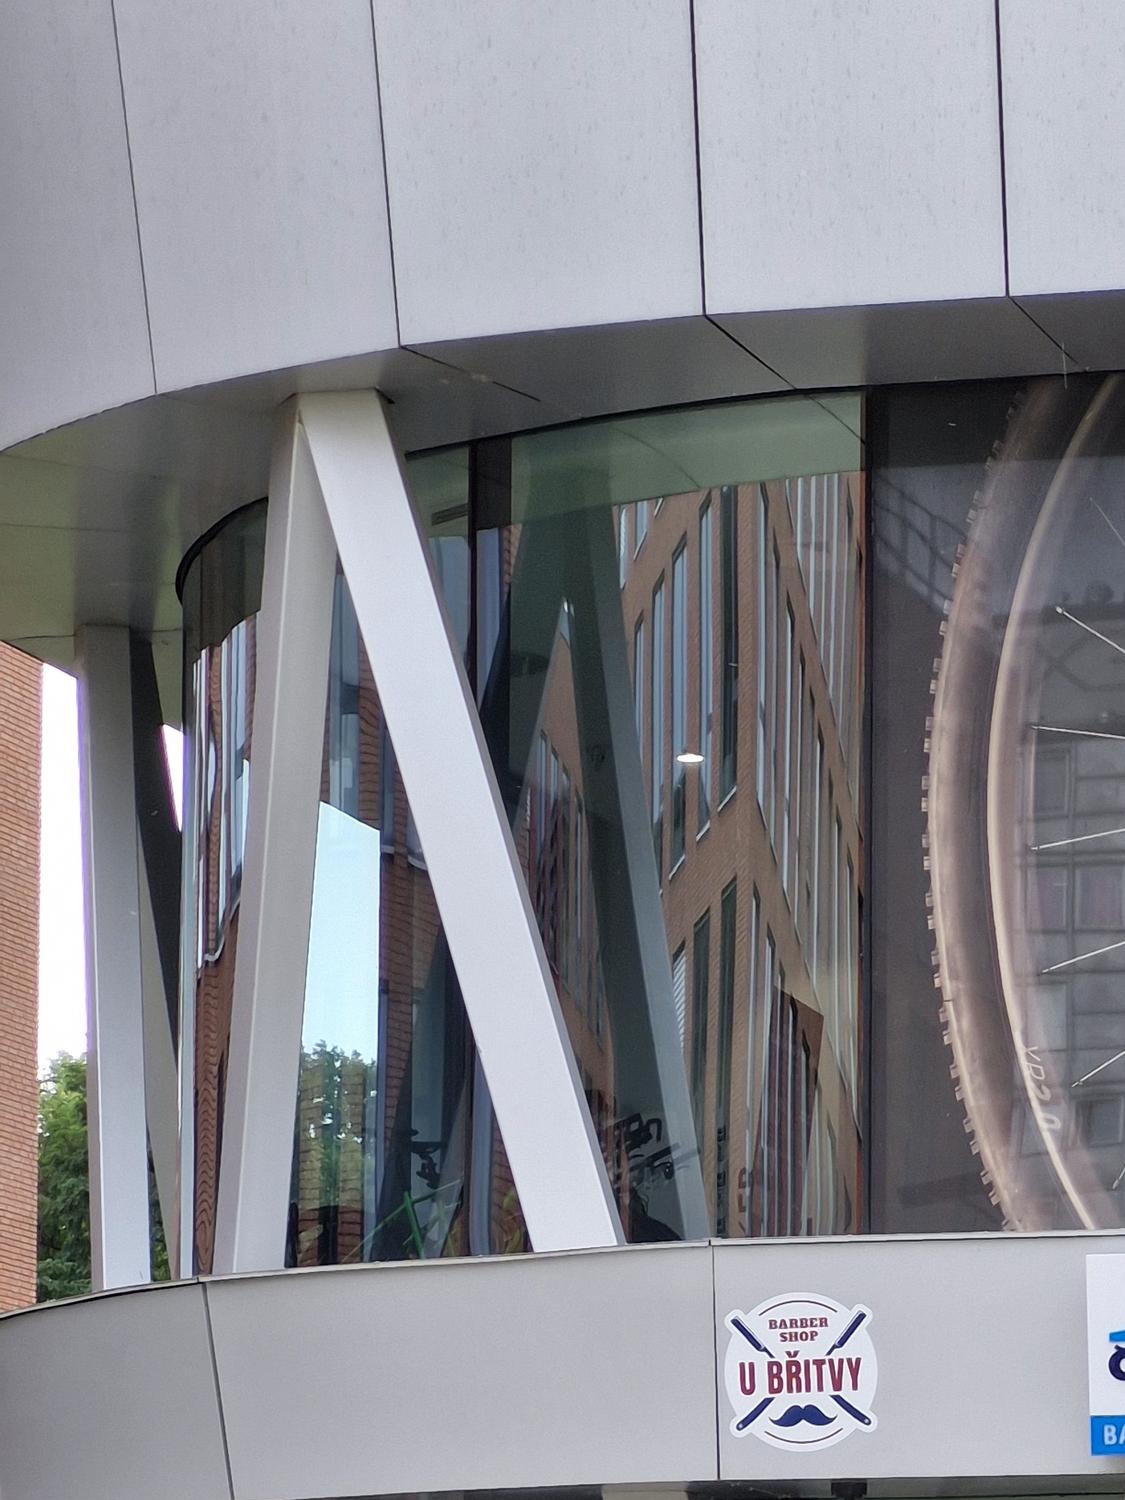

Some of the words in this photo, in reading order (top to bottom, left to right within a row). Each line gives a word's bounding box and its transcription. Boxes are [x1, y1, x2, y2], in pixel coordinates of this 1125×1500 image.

[768, 1317, 829, 1330] BARBER
[779, 1330, 819, 1343] SHOP
[738, 1361, 756, 1396] U
[767, 1350, 862, 1395] BŘITVY
